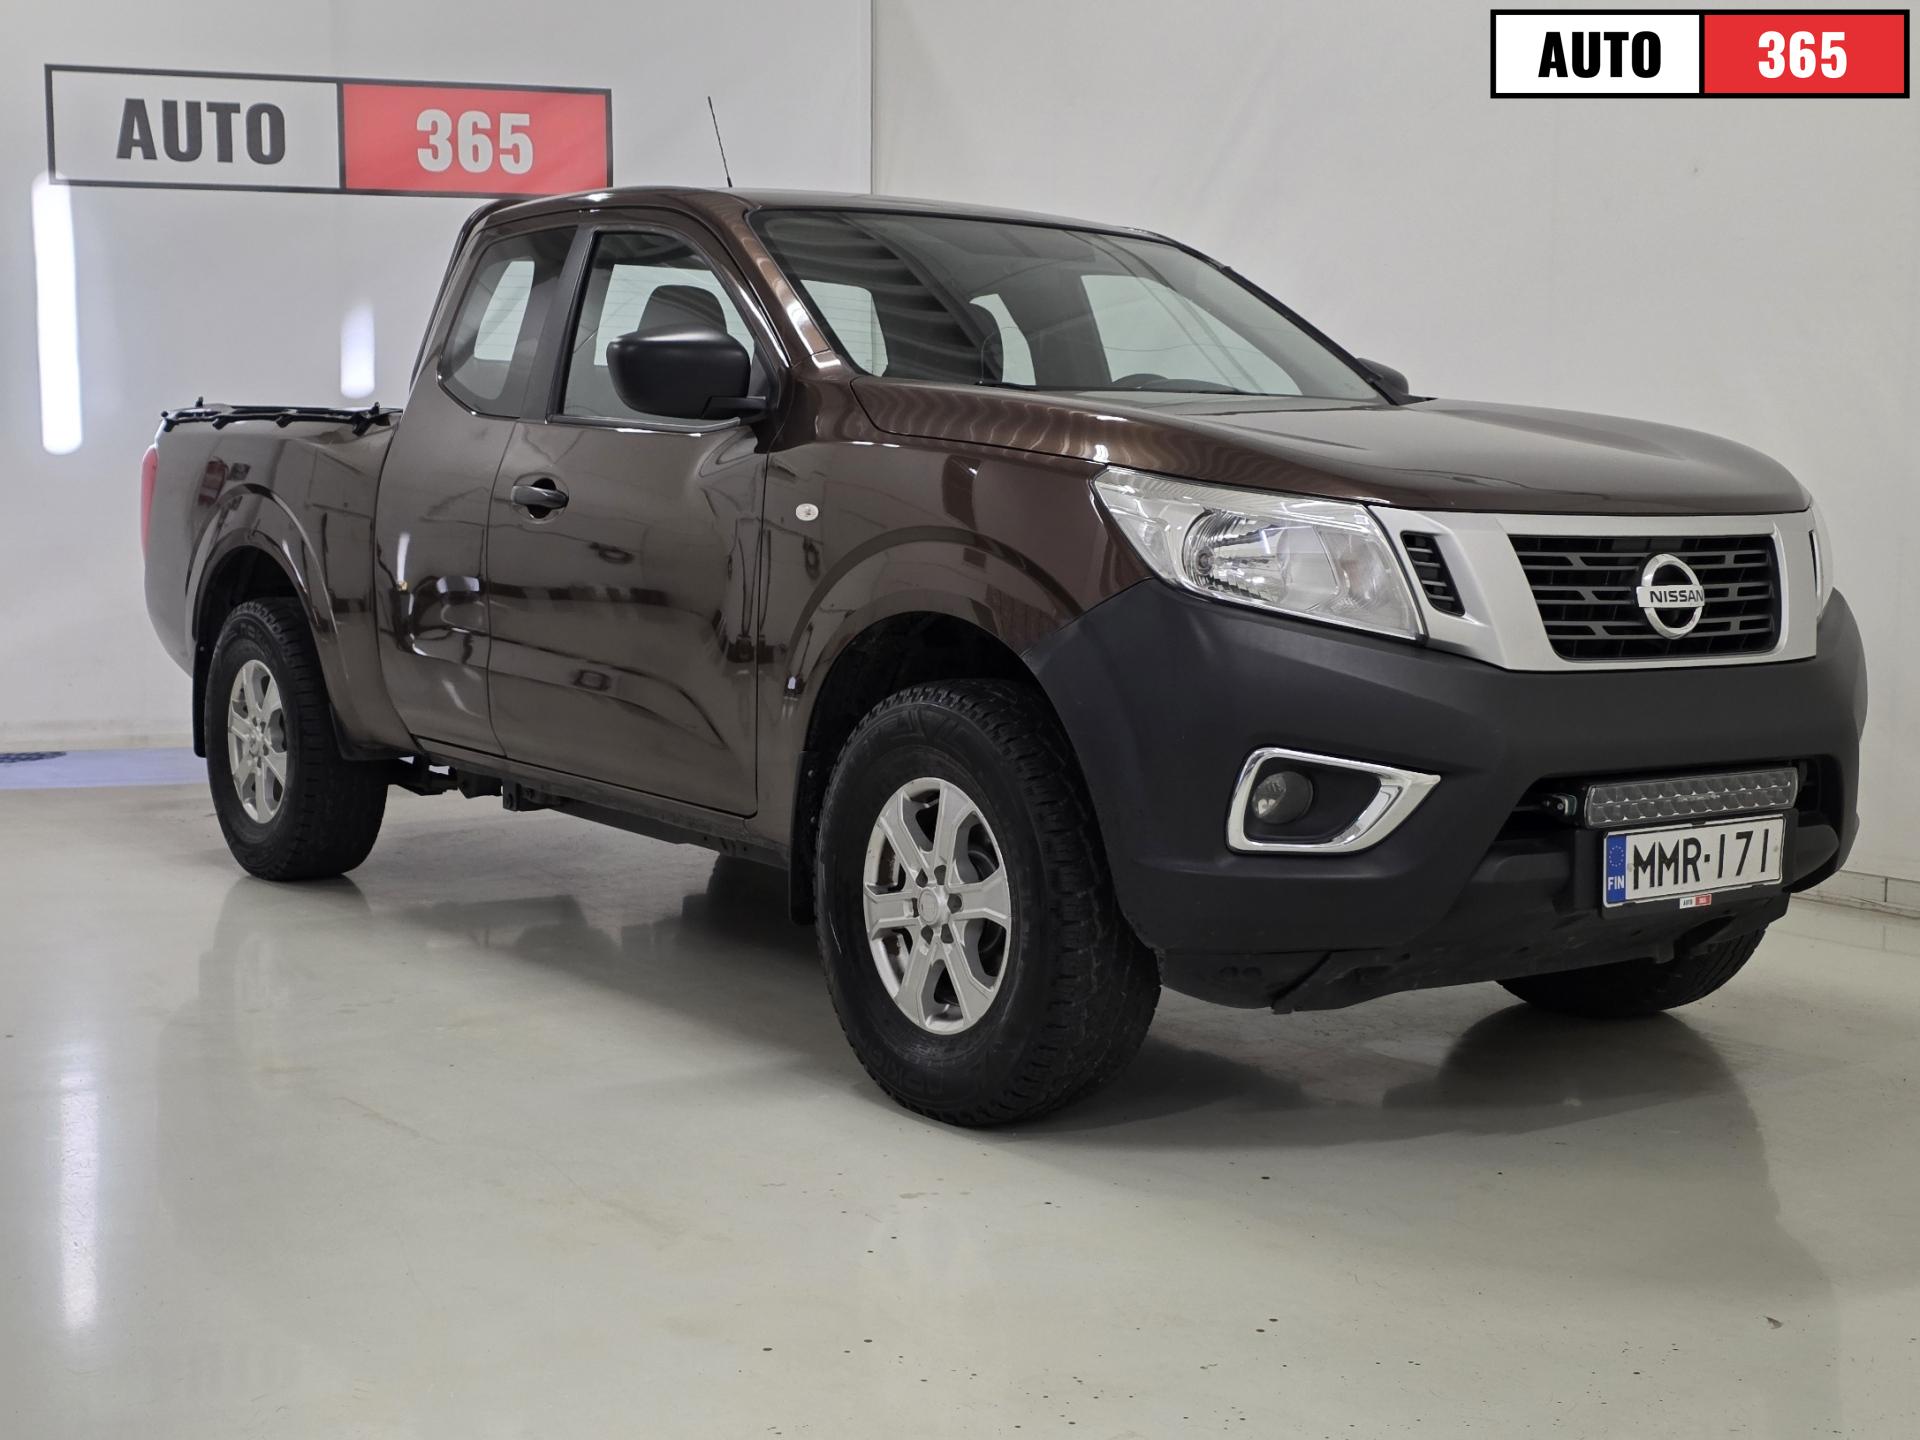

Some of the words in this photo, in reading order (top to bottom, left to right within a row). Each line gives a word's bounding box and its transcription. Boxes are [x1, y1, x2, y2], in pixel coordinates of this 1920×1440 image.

[116, 98, 286, 165] AUTO
[416, 109, 533, 175] 365
[1649, 589, 1704, 603] NISSAN
[1607, 875, 1625, 891] FIN
